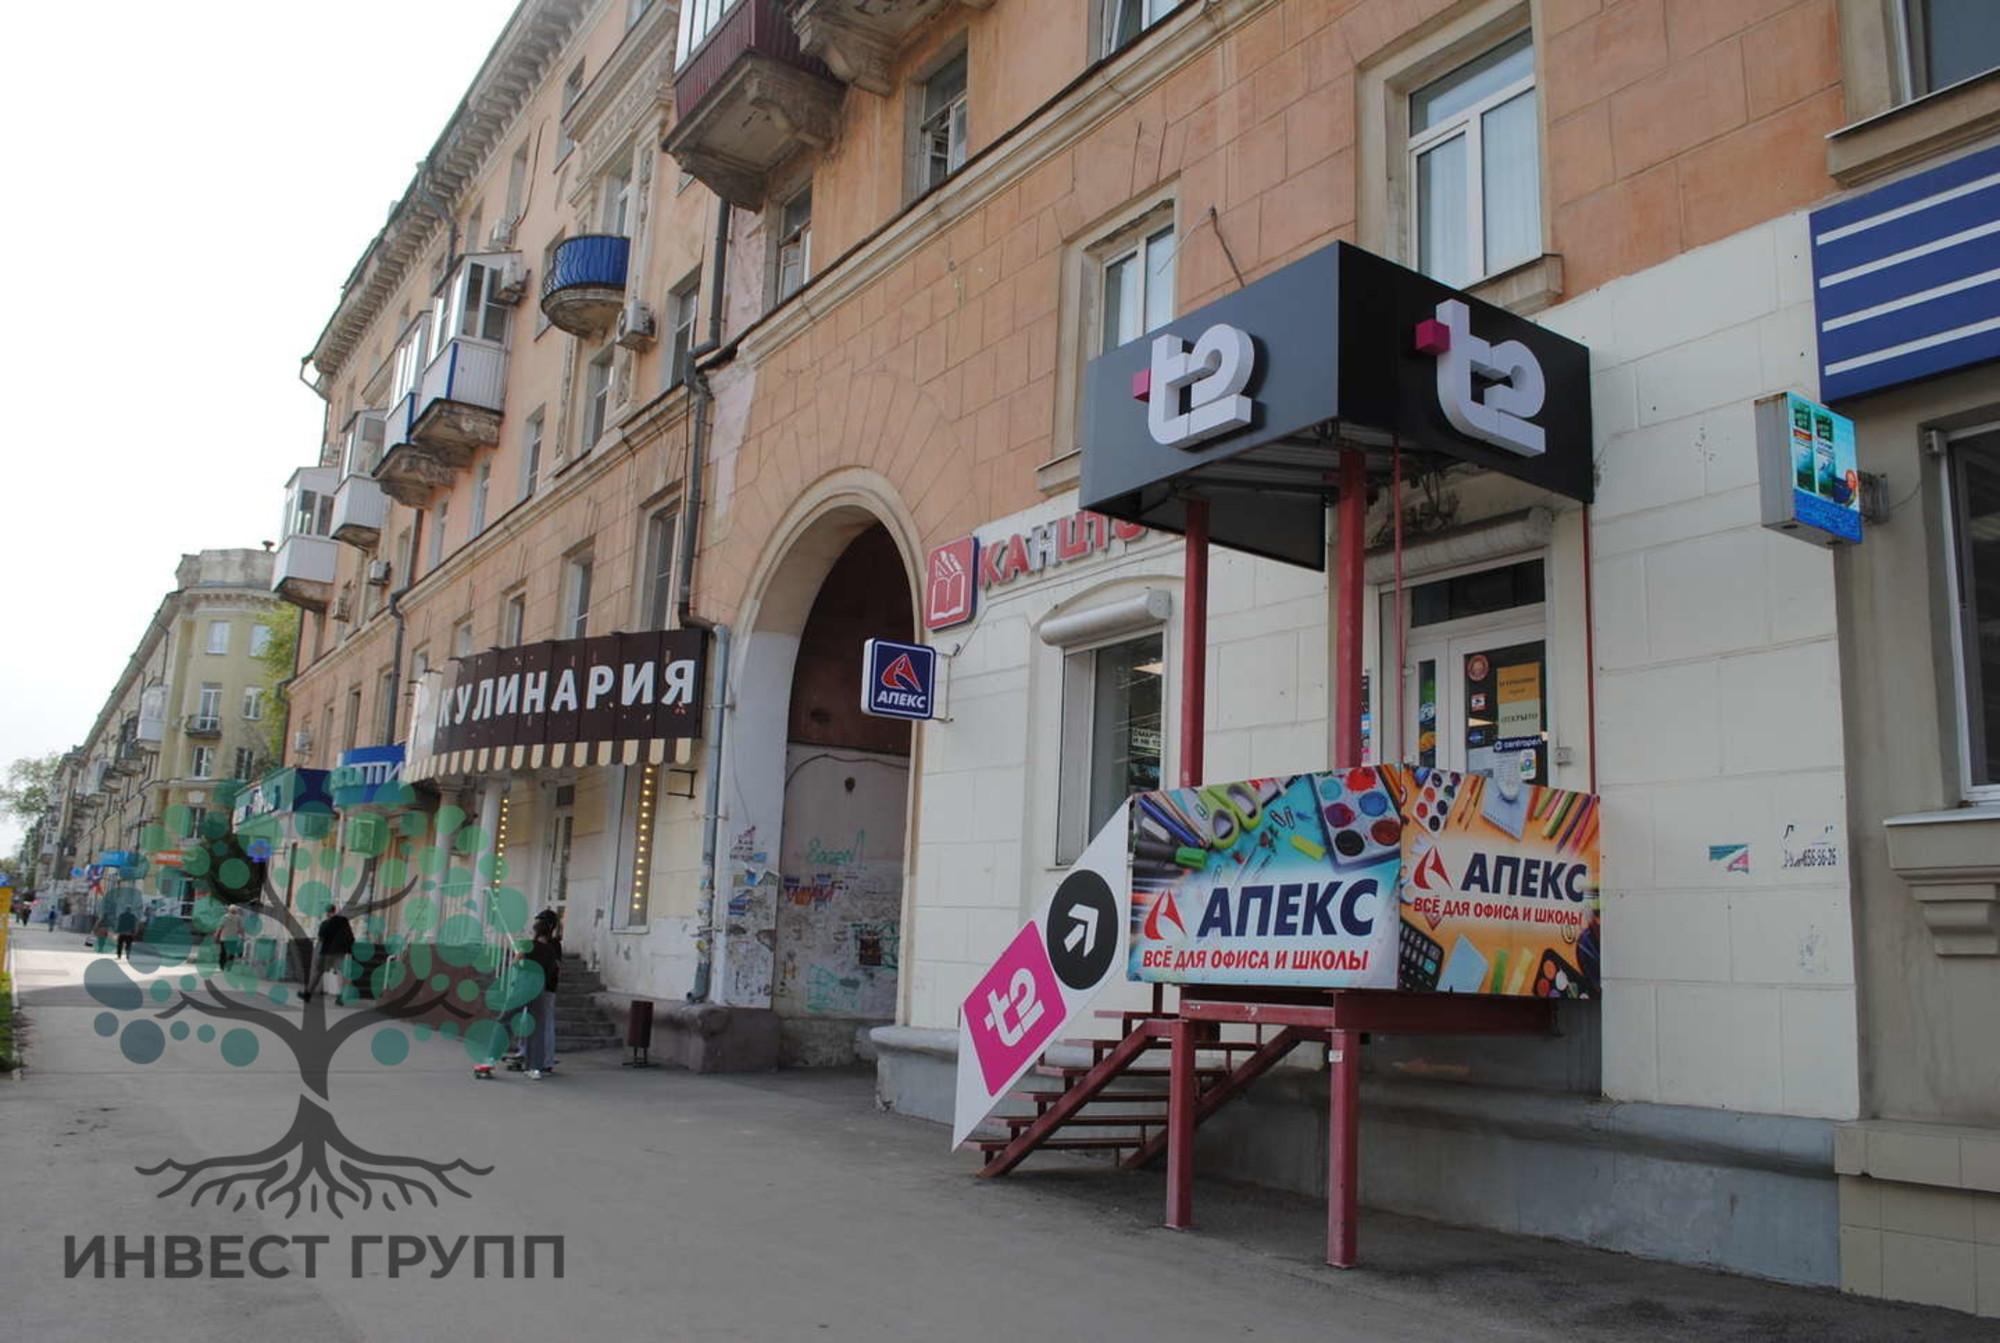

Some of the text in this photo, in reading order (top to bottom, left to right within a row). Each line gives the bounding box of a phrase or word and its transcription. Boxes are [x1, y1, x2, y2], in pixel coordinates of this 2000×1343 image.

[1133, 322, 1254, 450] t2
[1415, 299, 1546, 457] t2
[437, 659, 696, 728] КУЛИНАРИЯ
[877, 690, 926, 709] АПЕКС
[1460, 853, 1587, 903] АПЕКС
[1196, 879, 1379, 937] АПЕКС
[1413, 895, 1583, 926] ВСЁ ДЛЯ ОФИСА И ШКОЛЫ
[1143, 945, 1369, 970] ВСЁ ДЛЯ ОФИСА И ШКОЛЫ
[983, 968, 1044, 1047] t2
